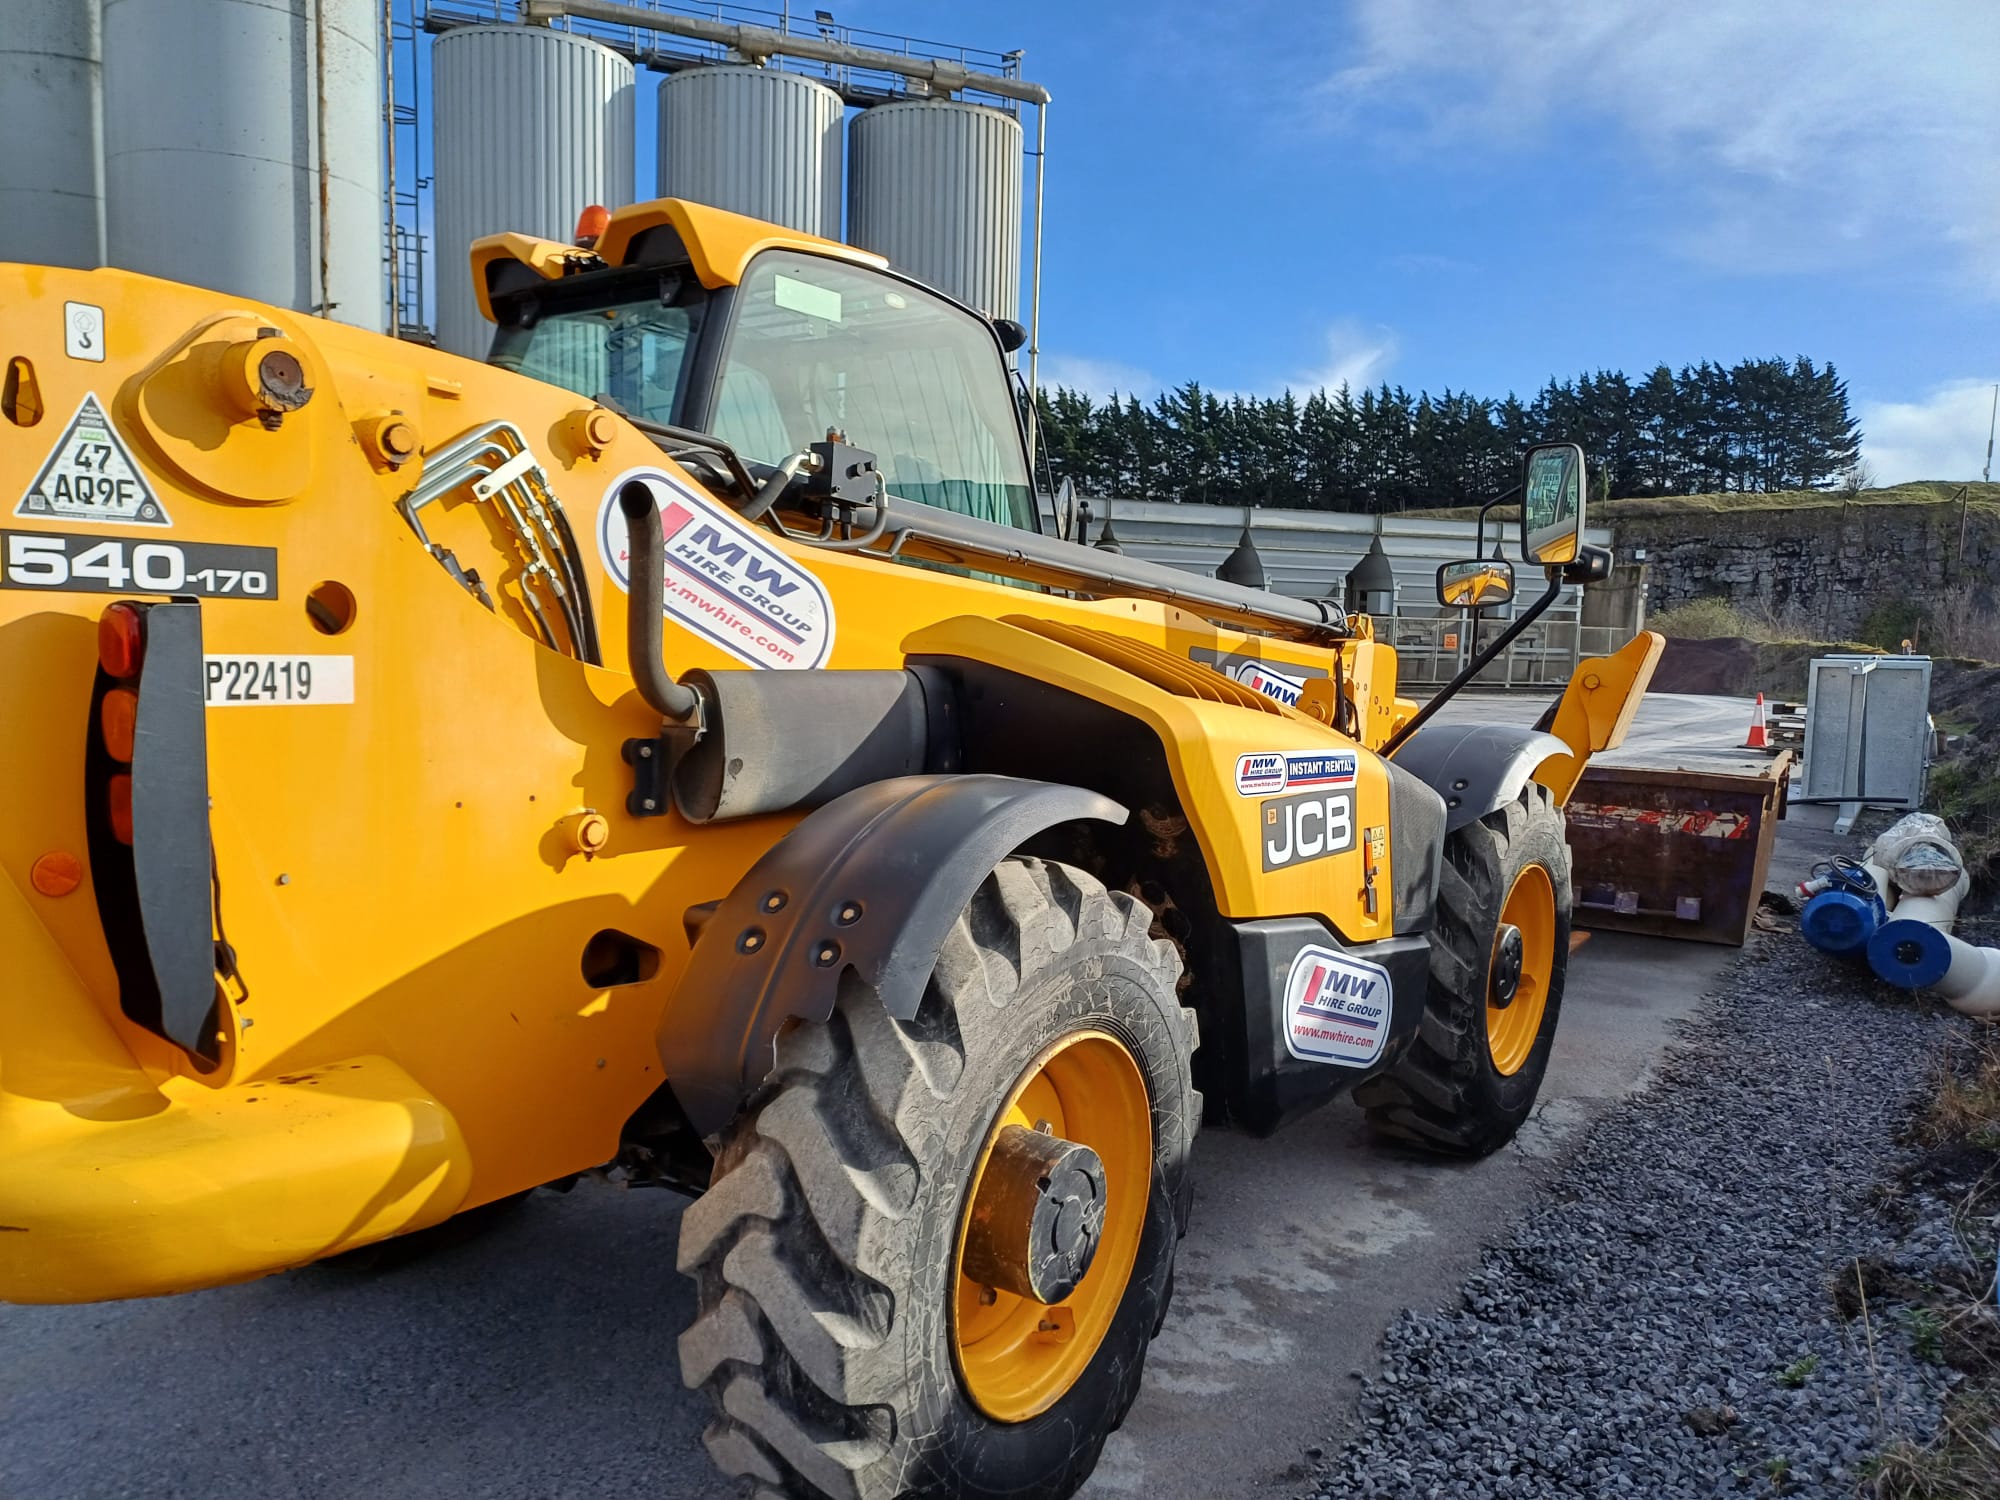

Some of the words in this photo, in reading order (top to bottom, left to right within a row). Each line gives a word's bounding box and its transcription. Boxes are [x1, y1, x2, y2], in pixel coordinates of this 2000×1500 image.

[75, 443, 112, 473] 47
[54, 474, 135, 507] AQ9F
[689, 524, 800, 597] MW
[674, 544, 736, 584] HIRE
[738, 585, 813, 633] GROUP
[205, 661, 311, 700] P22419
[1252, 758, 1277, 768] MW
[1289, 761, 1323, 776] INSTANT
[1324, 759, 1354, 773] RENTAL
[1267, 794, 1351, 865] JCB
[1324, 970, 1377, 999] MW
[1318, 995, 1346, 1010] HIRE
[1346, 1002, 1382, 1018] GROUP
[1294, 1024, 1375, 1049] www.mwhire.com
